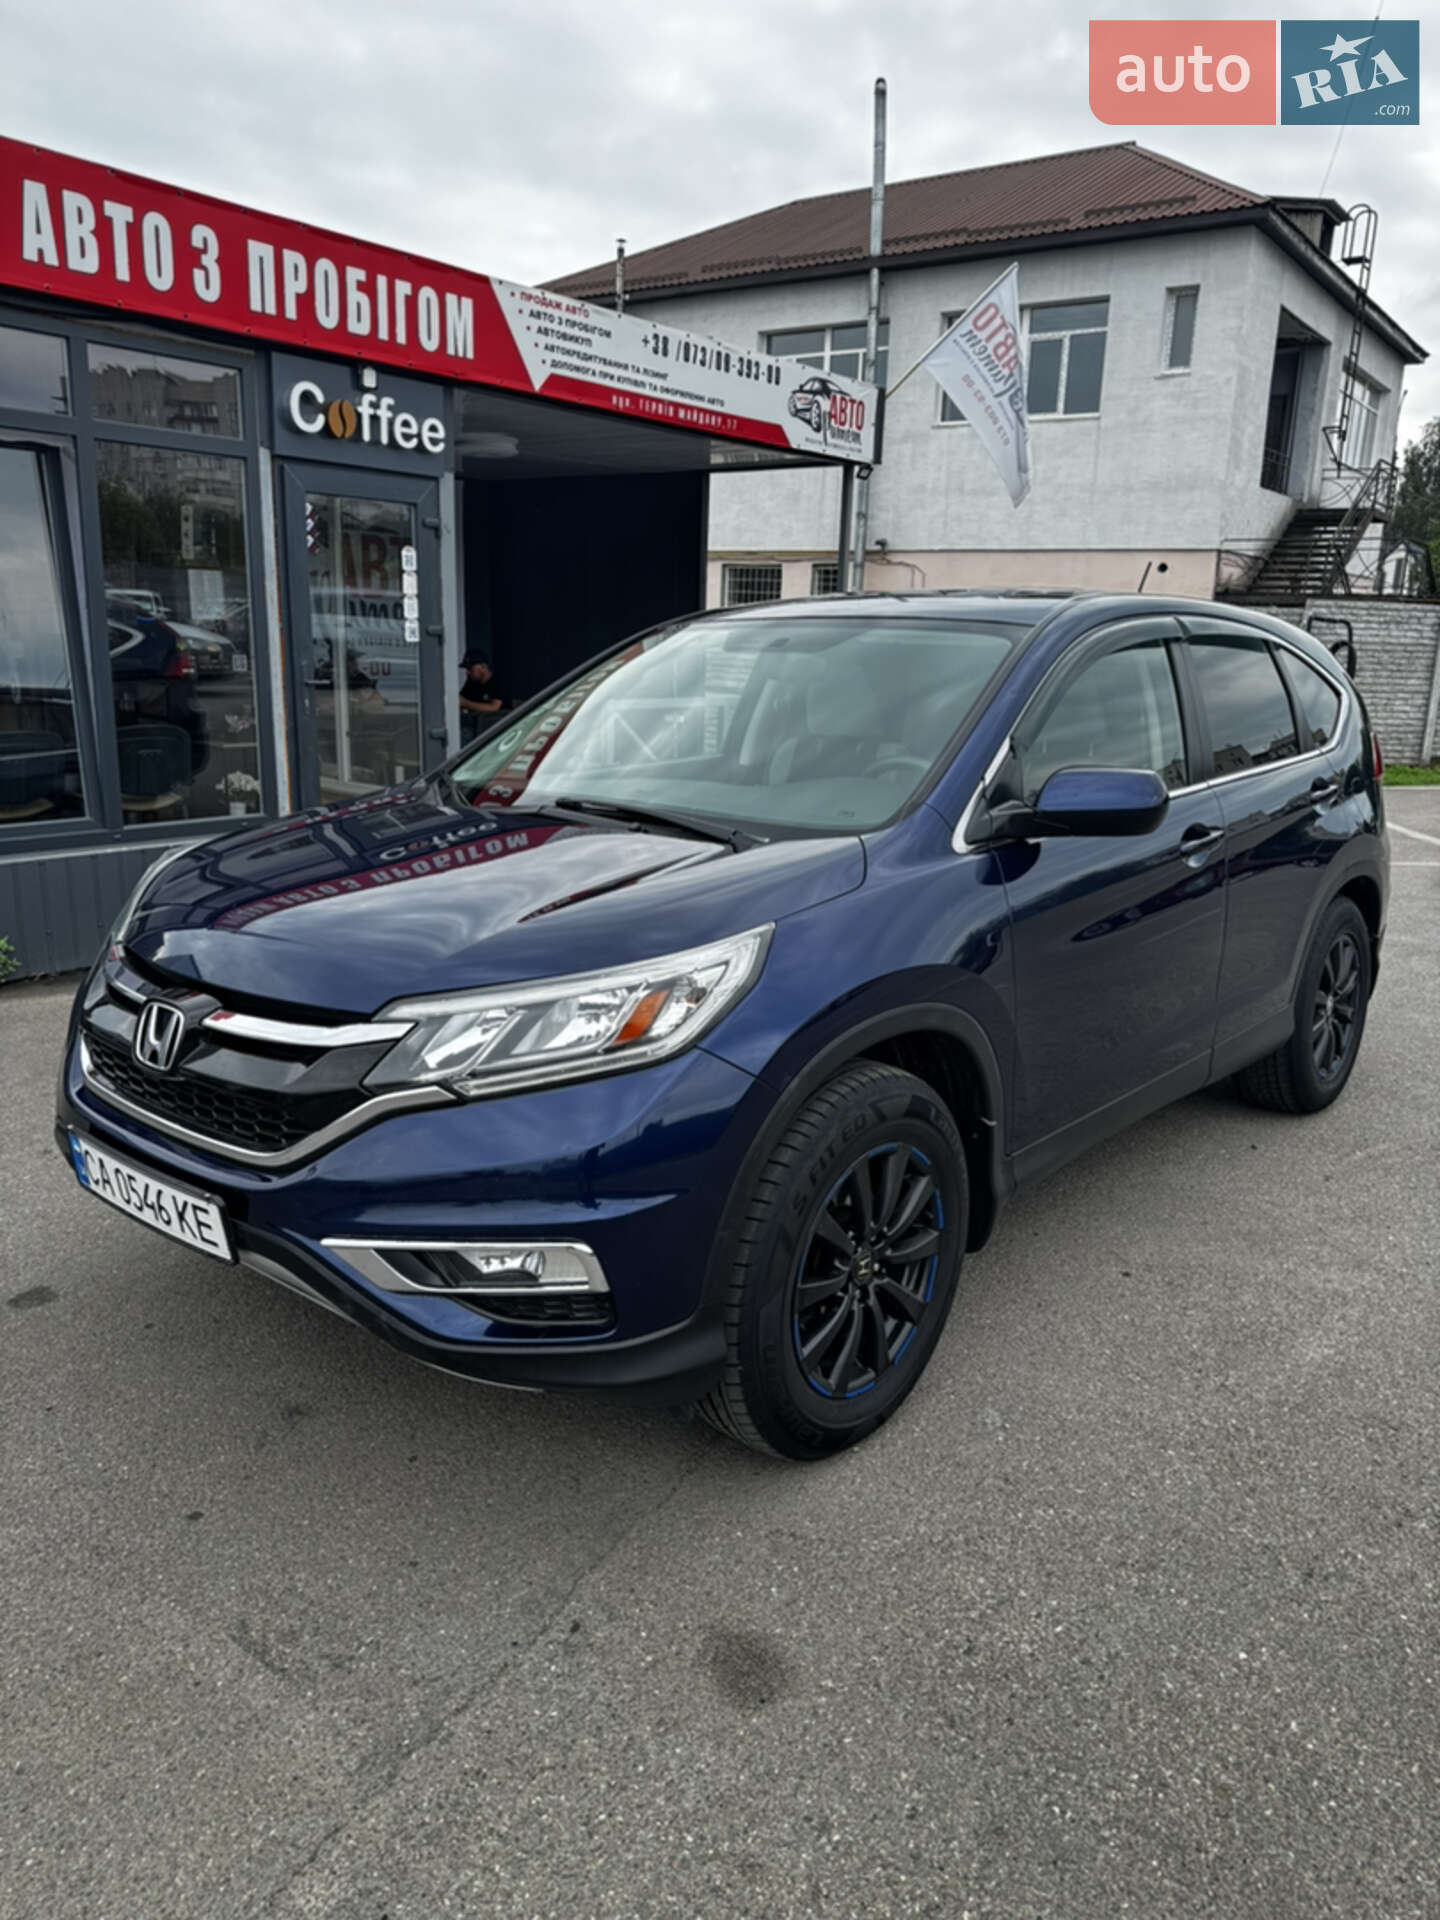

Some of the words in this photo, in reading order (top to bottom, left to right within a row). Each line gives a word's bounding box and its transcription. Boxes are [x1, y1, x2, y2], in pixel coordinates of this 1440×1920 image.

[22, 178, 174, 293] АВТО
[246, 238, 475, 360] ПРОБІГОМ
[520, 291, 562, 311] ПРОДАЖ
[565, 304, 590, 318] АВТО
[528, 309, 555, 324] АВТО
[565, 319, 612, 339] ПРОБІГОМ
[536, 325, 592, 347] АВТОВИКУП
[641, 333, 669, 357] +38
[550, 359, 596, 377] ДОПОМОГА
[598, 370, 615, 382] ПРИ
[631, 364, 641, 375] ТА
[290, 380, 445, 453] Coffee
[828, 393, 865, 431] АВТО
